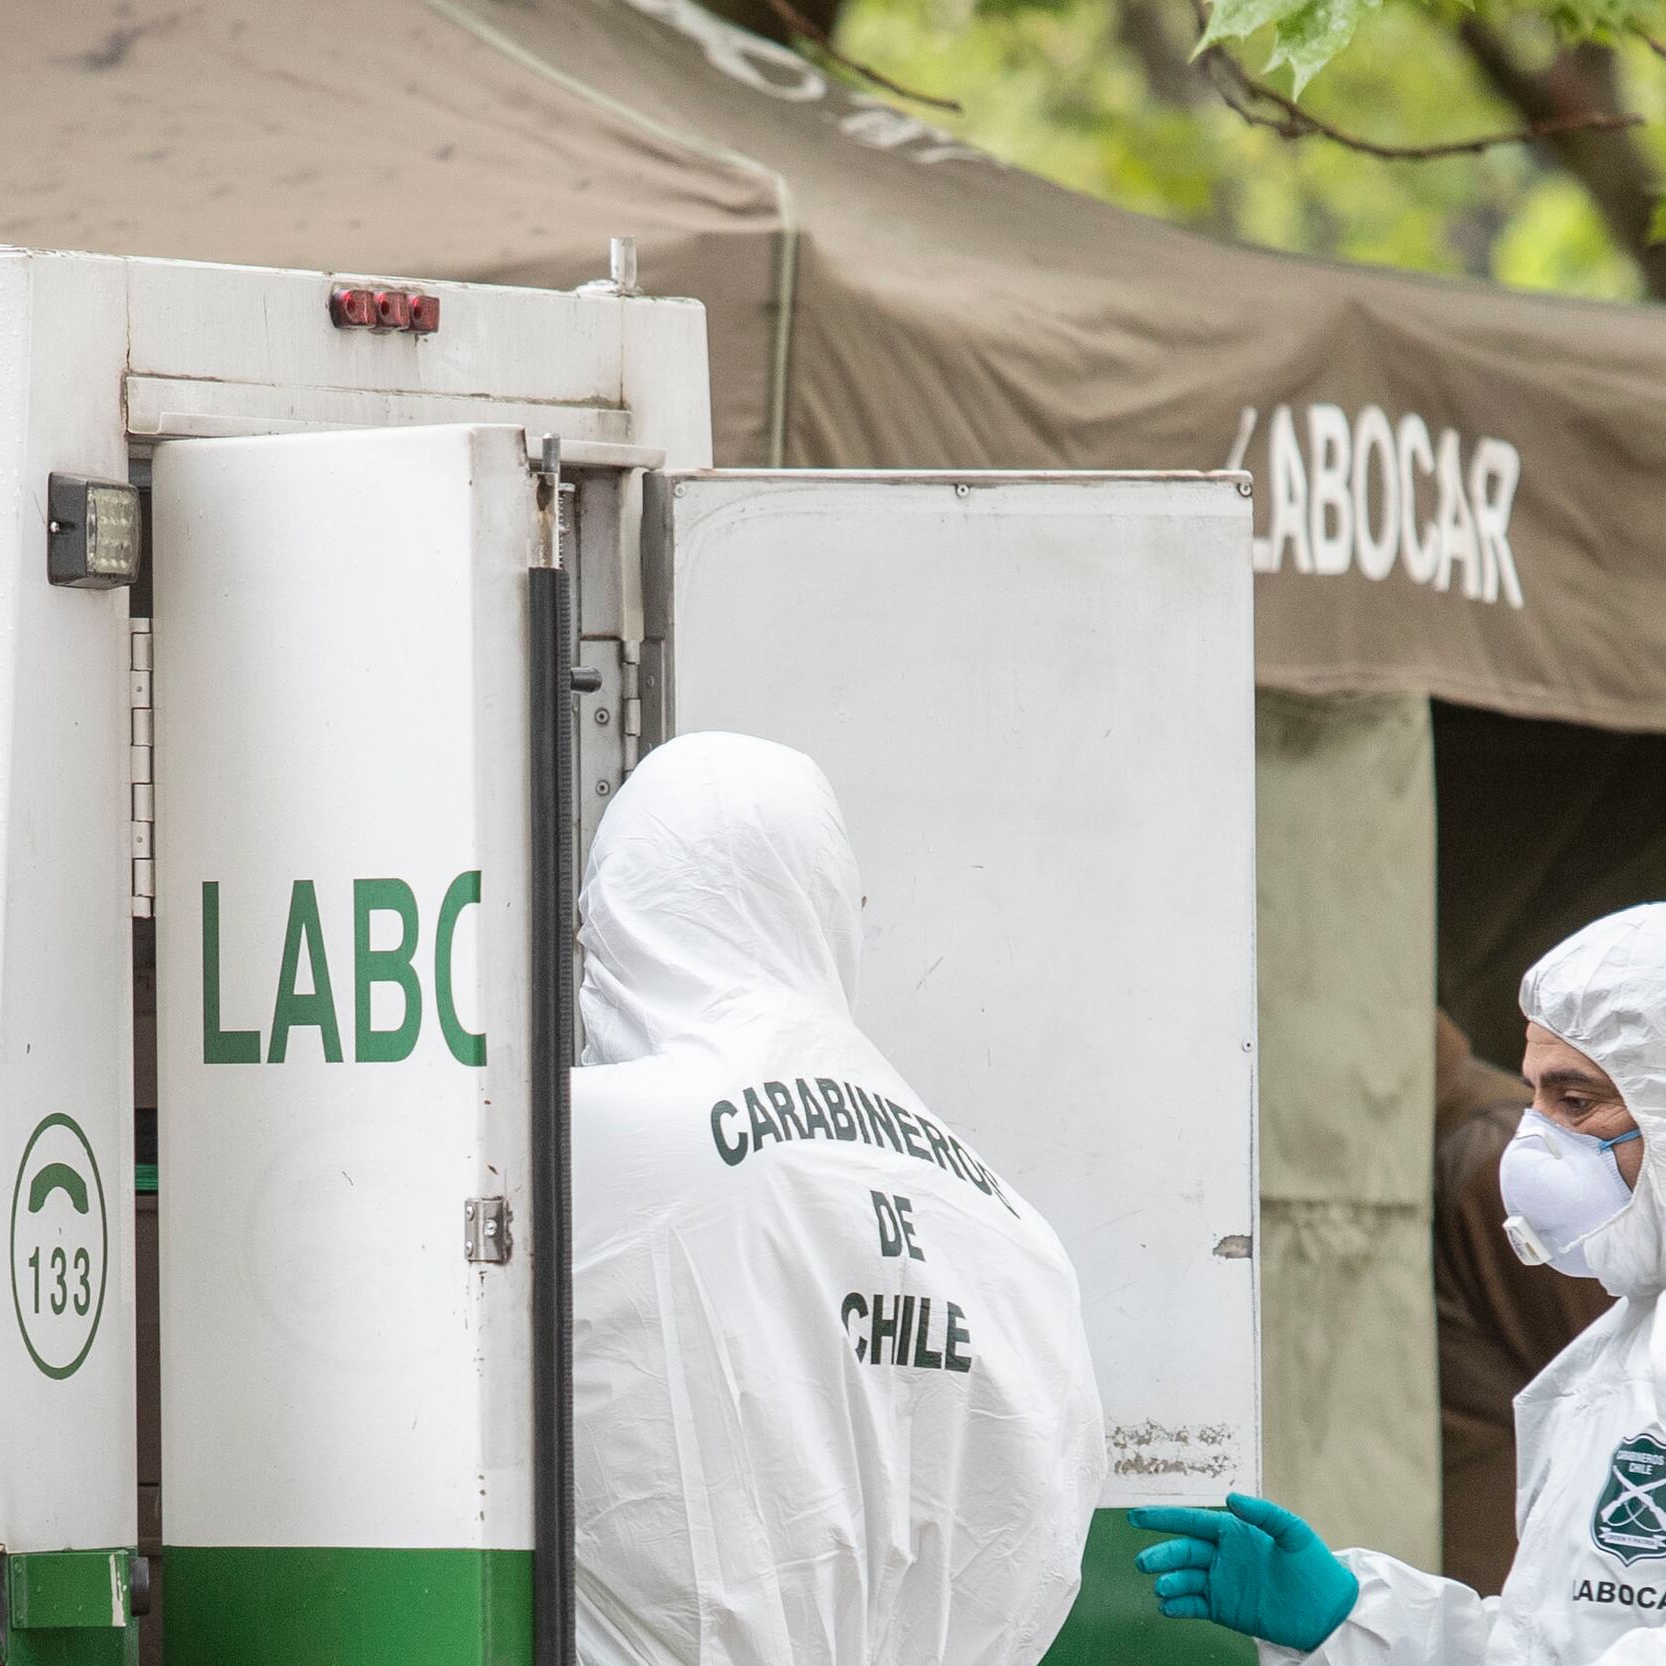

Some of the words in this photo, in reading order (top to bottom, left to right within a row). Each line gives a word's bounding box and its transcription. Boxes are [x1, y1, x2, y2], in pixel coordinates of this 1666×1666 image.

[869, 1189, 927, 1262] DE
[28, 1245, 91, 1317] 133
[841, 1292, 973, 1374] CHILE
